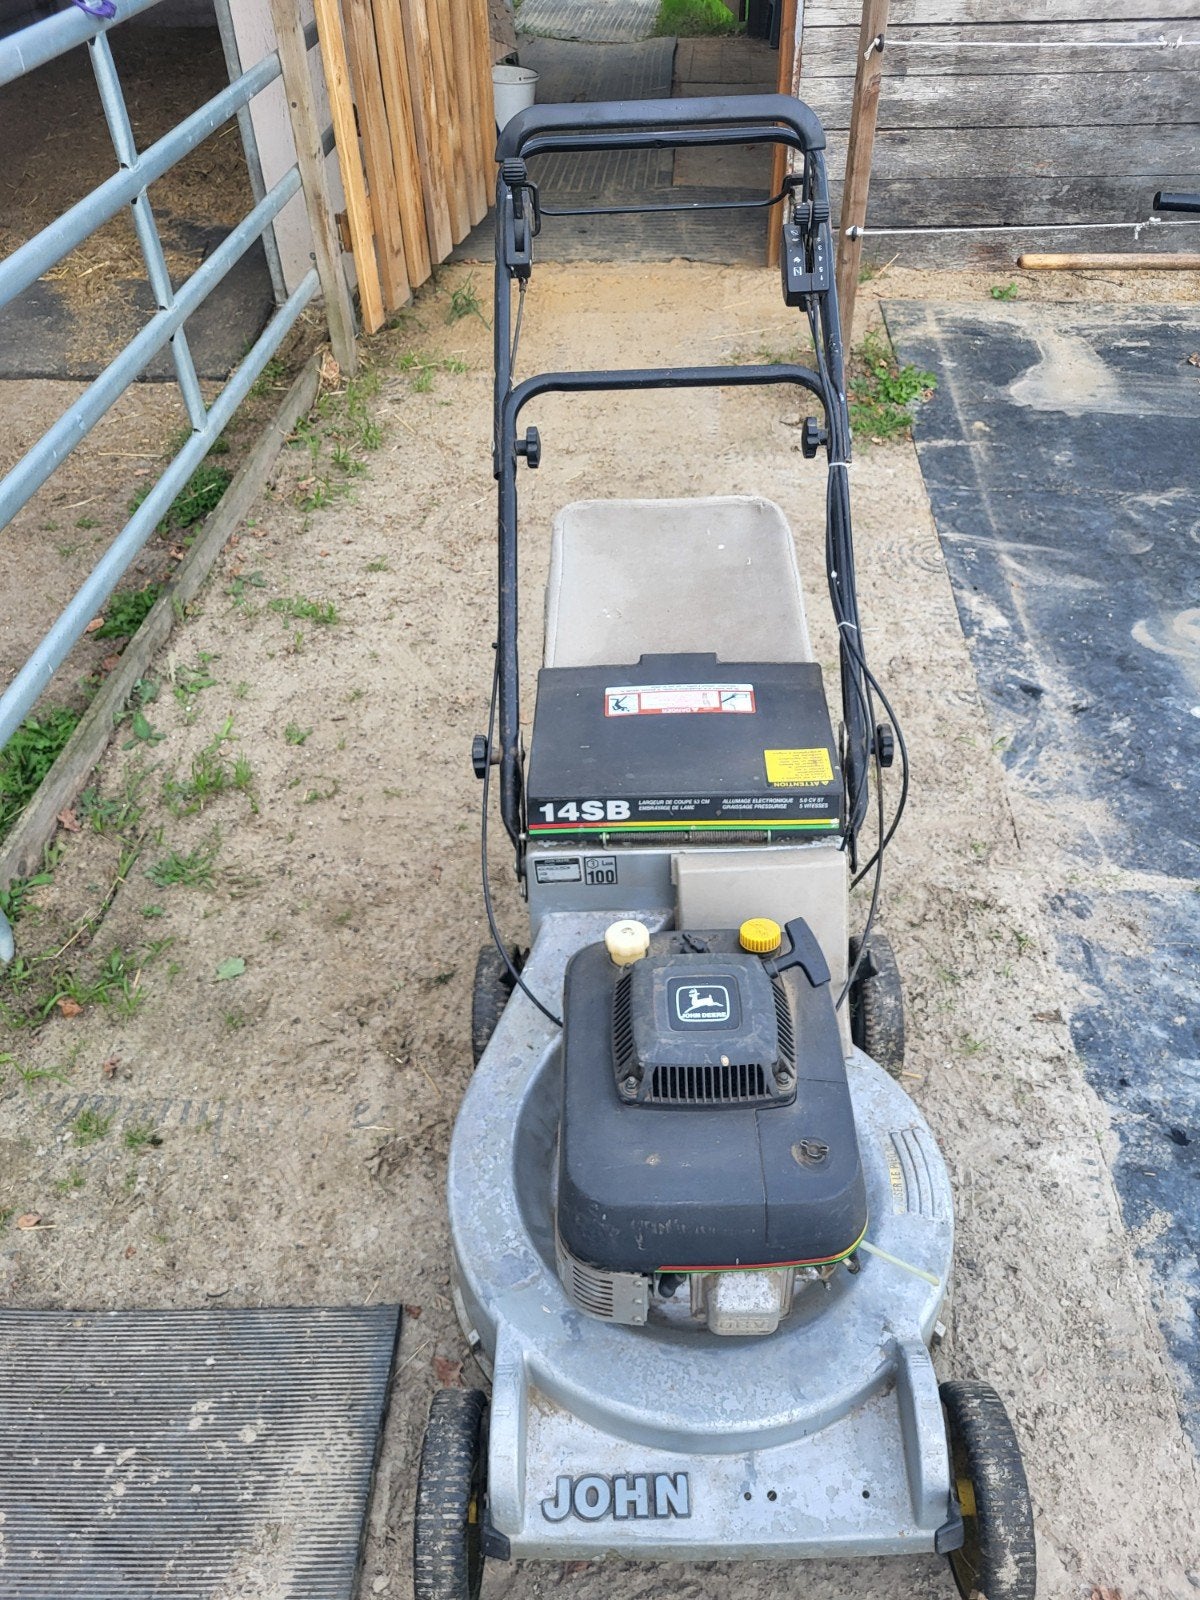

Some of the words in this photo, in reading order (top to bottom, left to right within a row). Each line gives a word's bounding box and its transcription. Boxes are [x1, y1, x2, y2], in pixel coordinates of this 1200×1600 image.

[539, 800, 631, 822] 14SB
[588, 870, 614, 883] 100
[541, 1472, 692, 1522] JOHN
